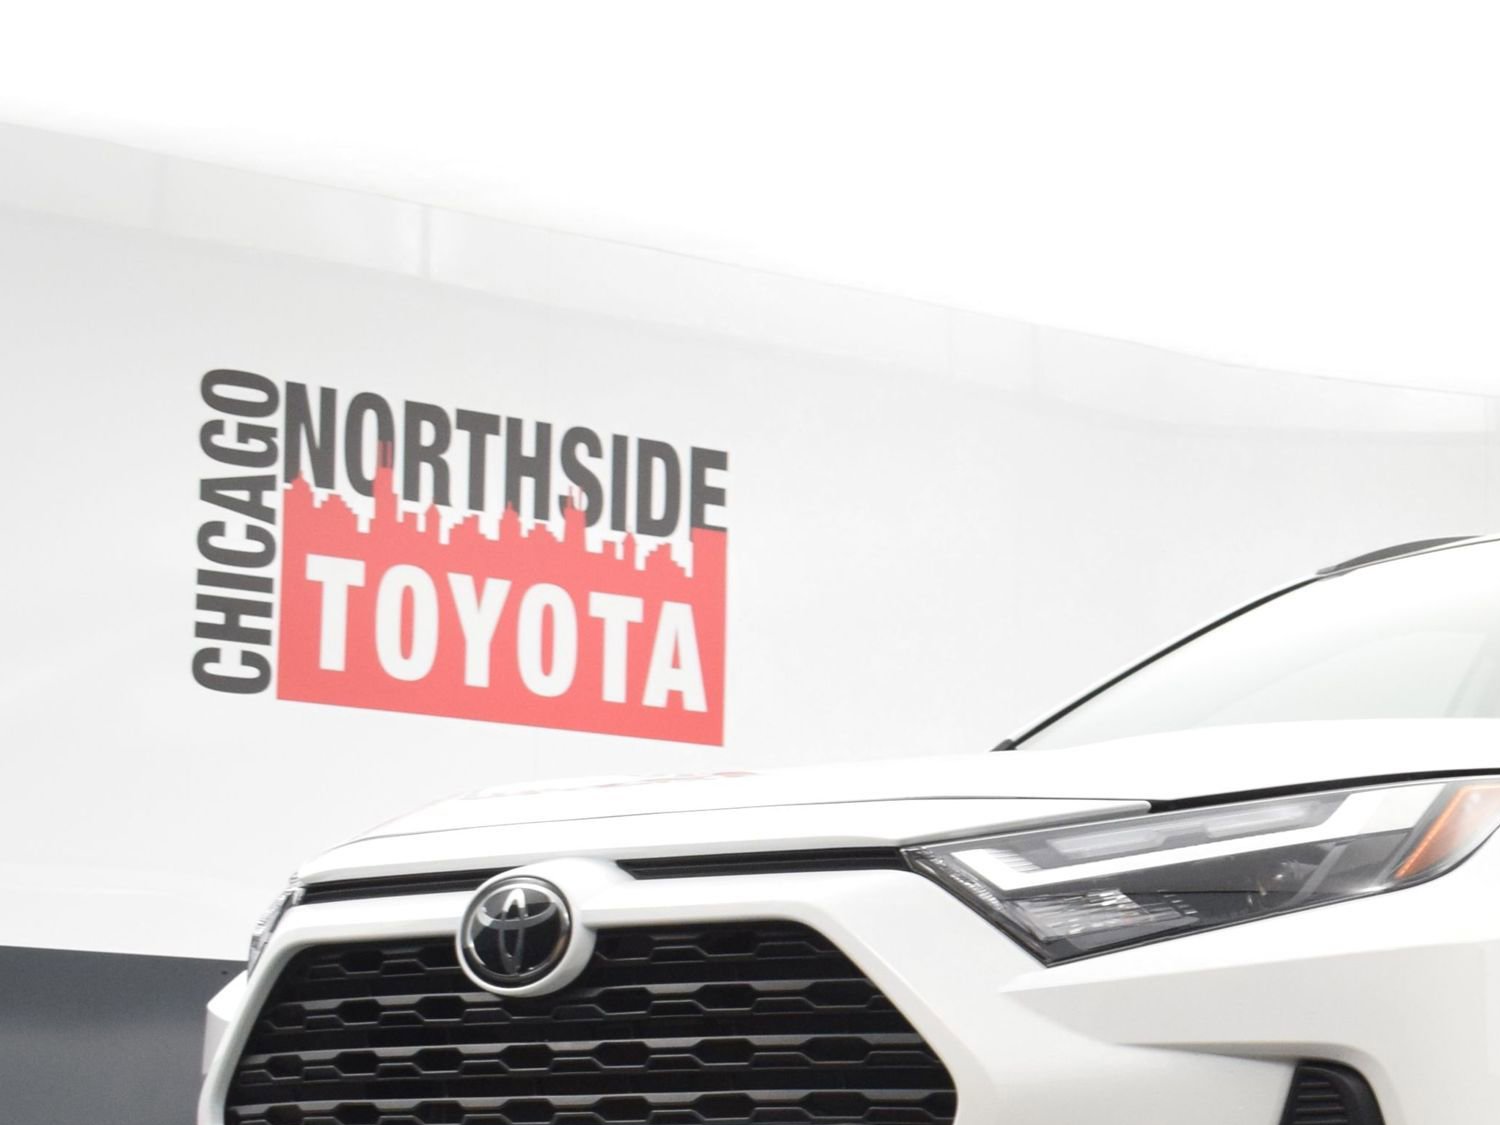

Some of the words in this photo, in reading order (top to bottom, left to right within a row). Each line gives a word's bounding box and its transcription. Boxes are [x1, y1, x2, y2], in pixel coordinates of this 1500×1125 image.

[191, 367, 280, 695] CHICAGO
[283, 380, 729, 538] NORTHSIDE
[305, 553, 708, 712] TOYOTA
